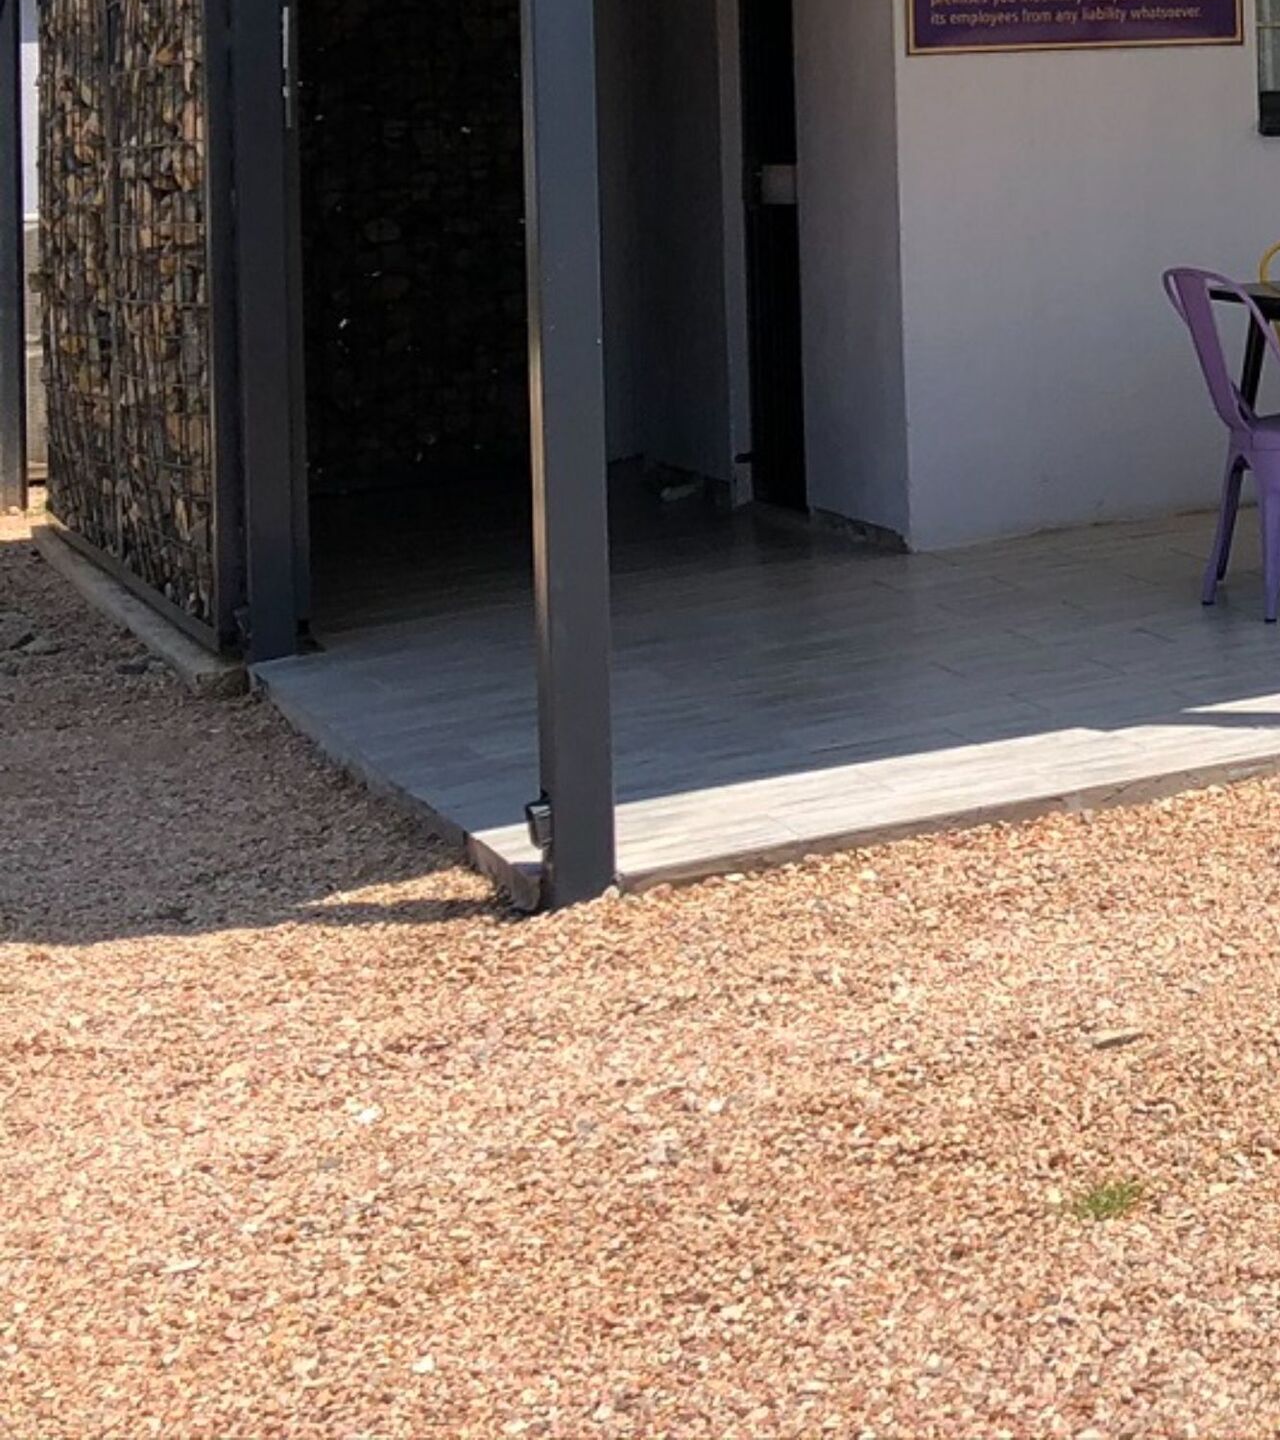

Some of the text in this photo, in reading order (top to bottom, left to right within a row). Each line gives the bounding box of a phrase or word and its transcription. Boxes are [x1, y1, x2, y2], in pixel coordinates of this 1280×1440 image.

[950, 9, 1018, 26] employees
[1022, 8, 1052, 23] from
[1056, 11, 1079, 24] any
